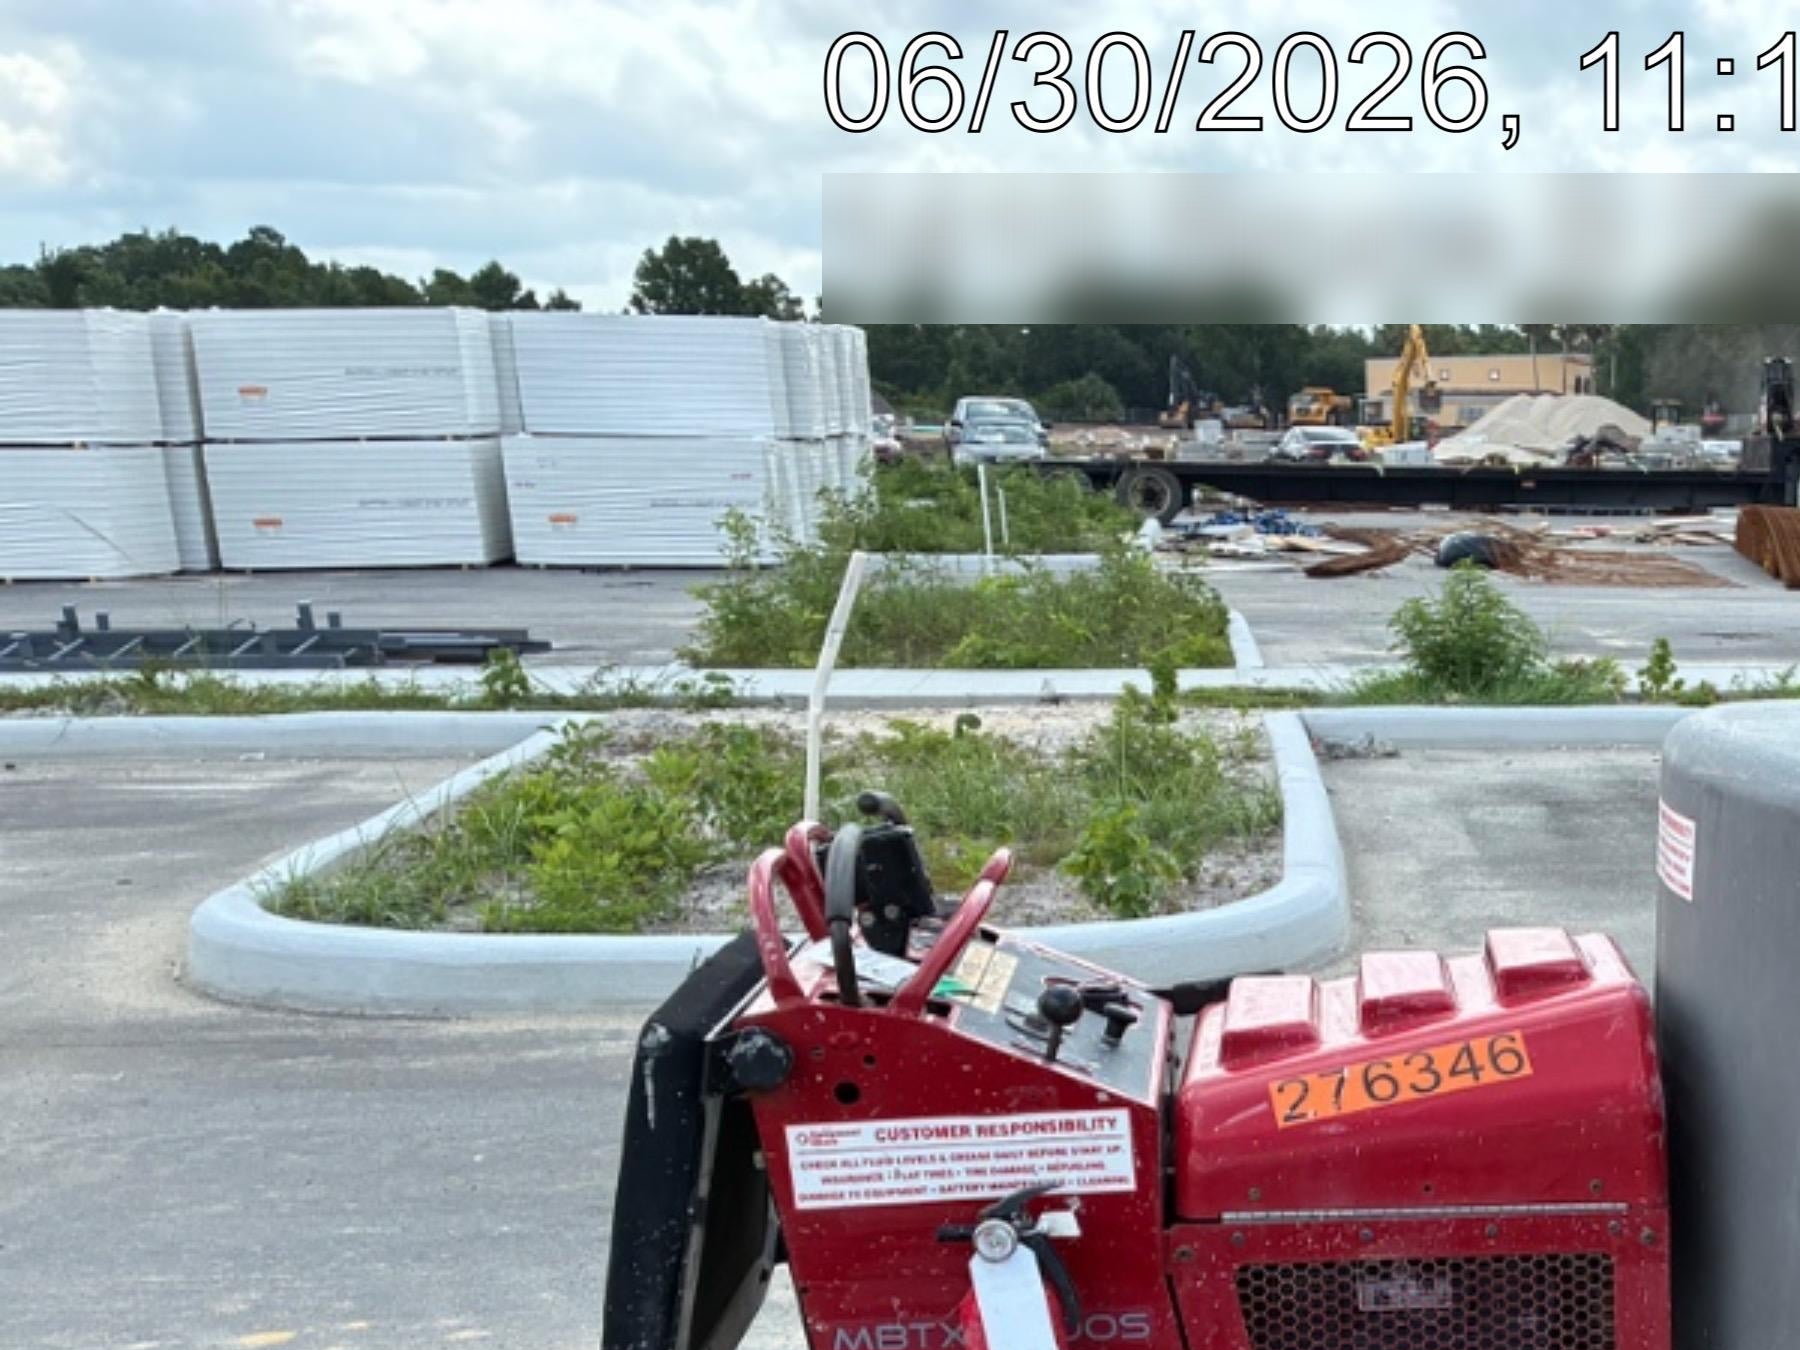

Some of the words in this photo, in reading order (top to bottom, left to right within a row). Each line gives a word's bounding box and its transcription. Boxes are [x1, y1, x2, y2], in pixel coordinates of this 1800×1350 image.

[1278, 1034, 1526, 1122] 276346
[875, 1123, 971, 1143] CUSTOMER
[976, 1116, 1117, 1138] RESPONSIBILITY
